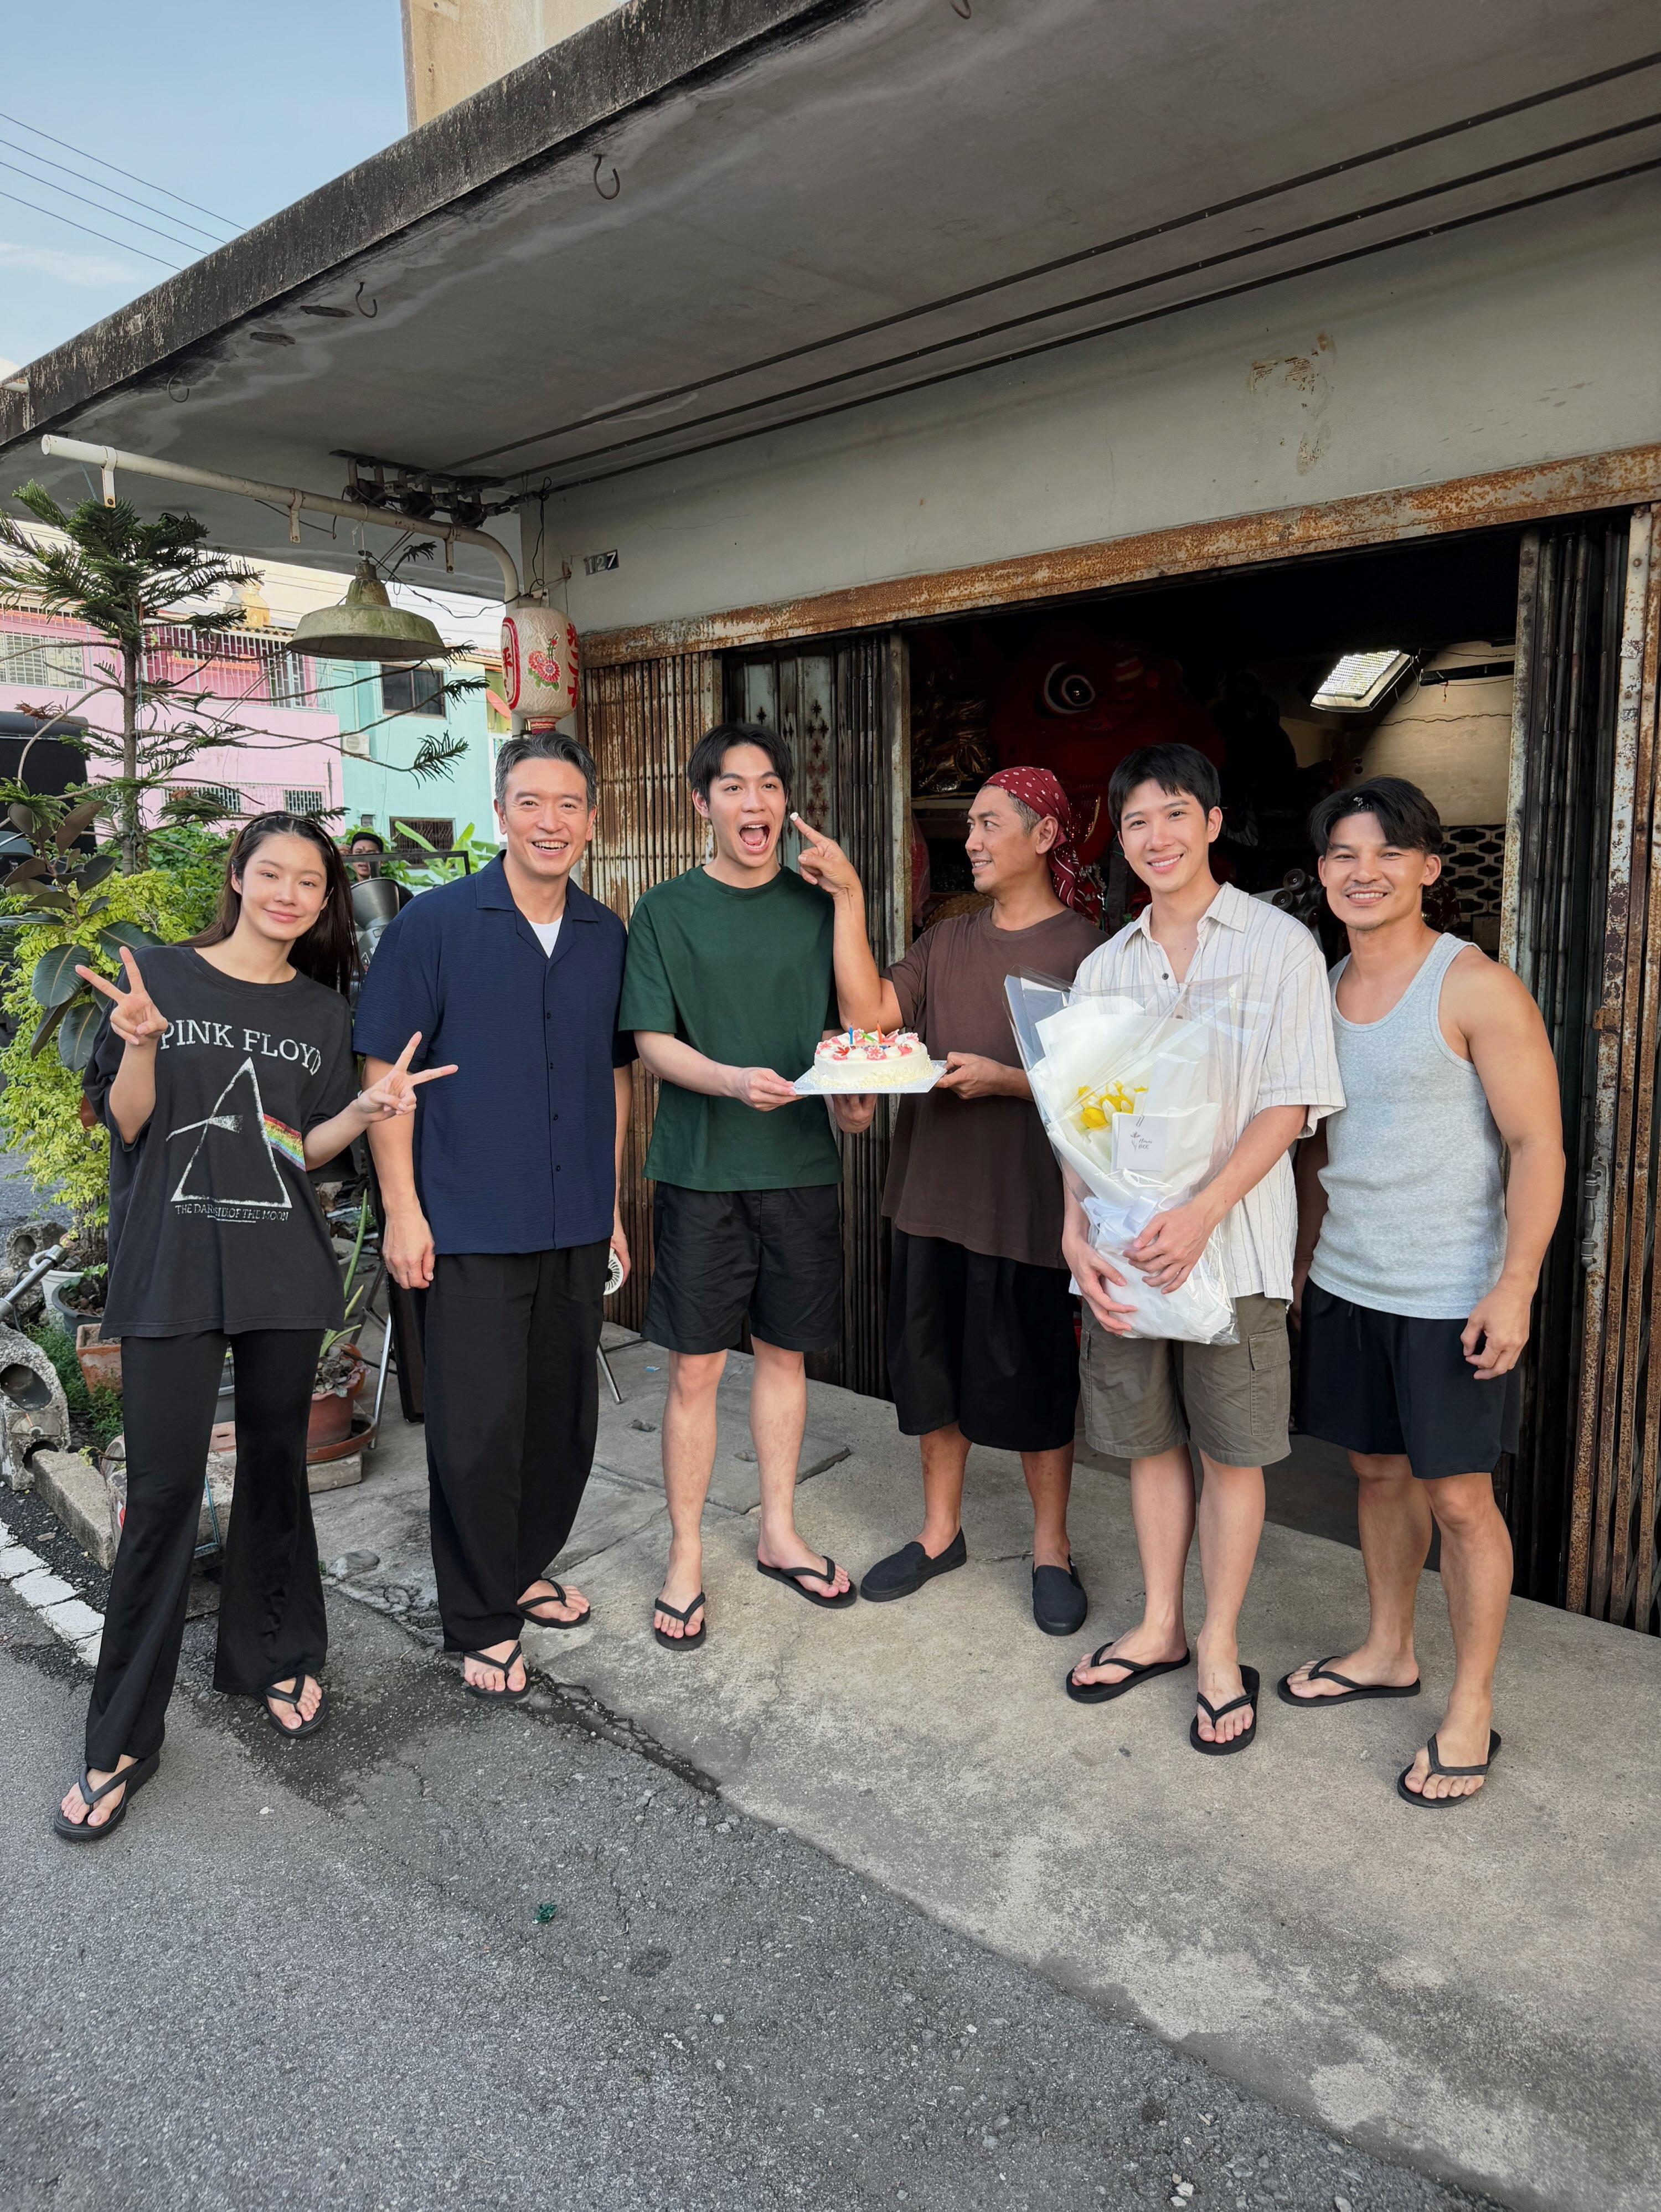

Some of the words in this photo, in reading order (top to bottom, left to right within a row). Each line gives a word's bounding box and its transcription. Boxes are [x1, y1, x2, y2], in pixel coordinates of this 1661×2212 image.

[589, 551, 616, 574] 127
[161, 1019, 234, 1050] PINK
[243, 1028, 322, 1076] FLOYD
[175, 1204, 192, 1214] THE
[194, 1204, 215, 1214] DAR
[215, 1207, 229, 1217] SID
[229, 1208, 241, 1218] OF
[243, 1209, 260, 1219] THE
